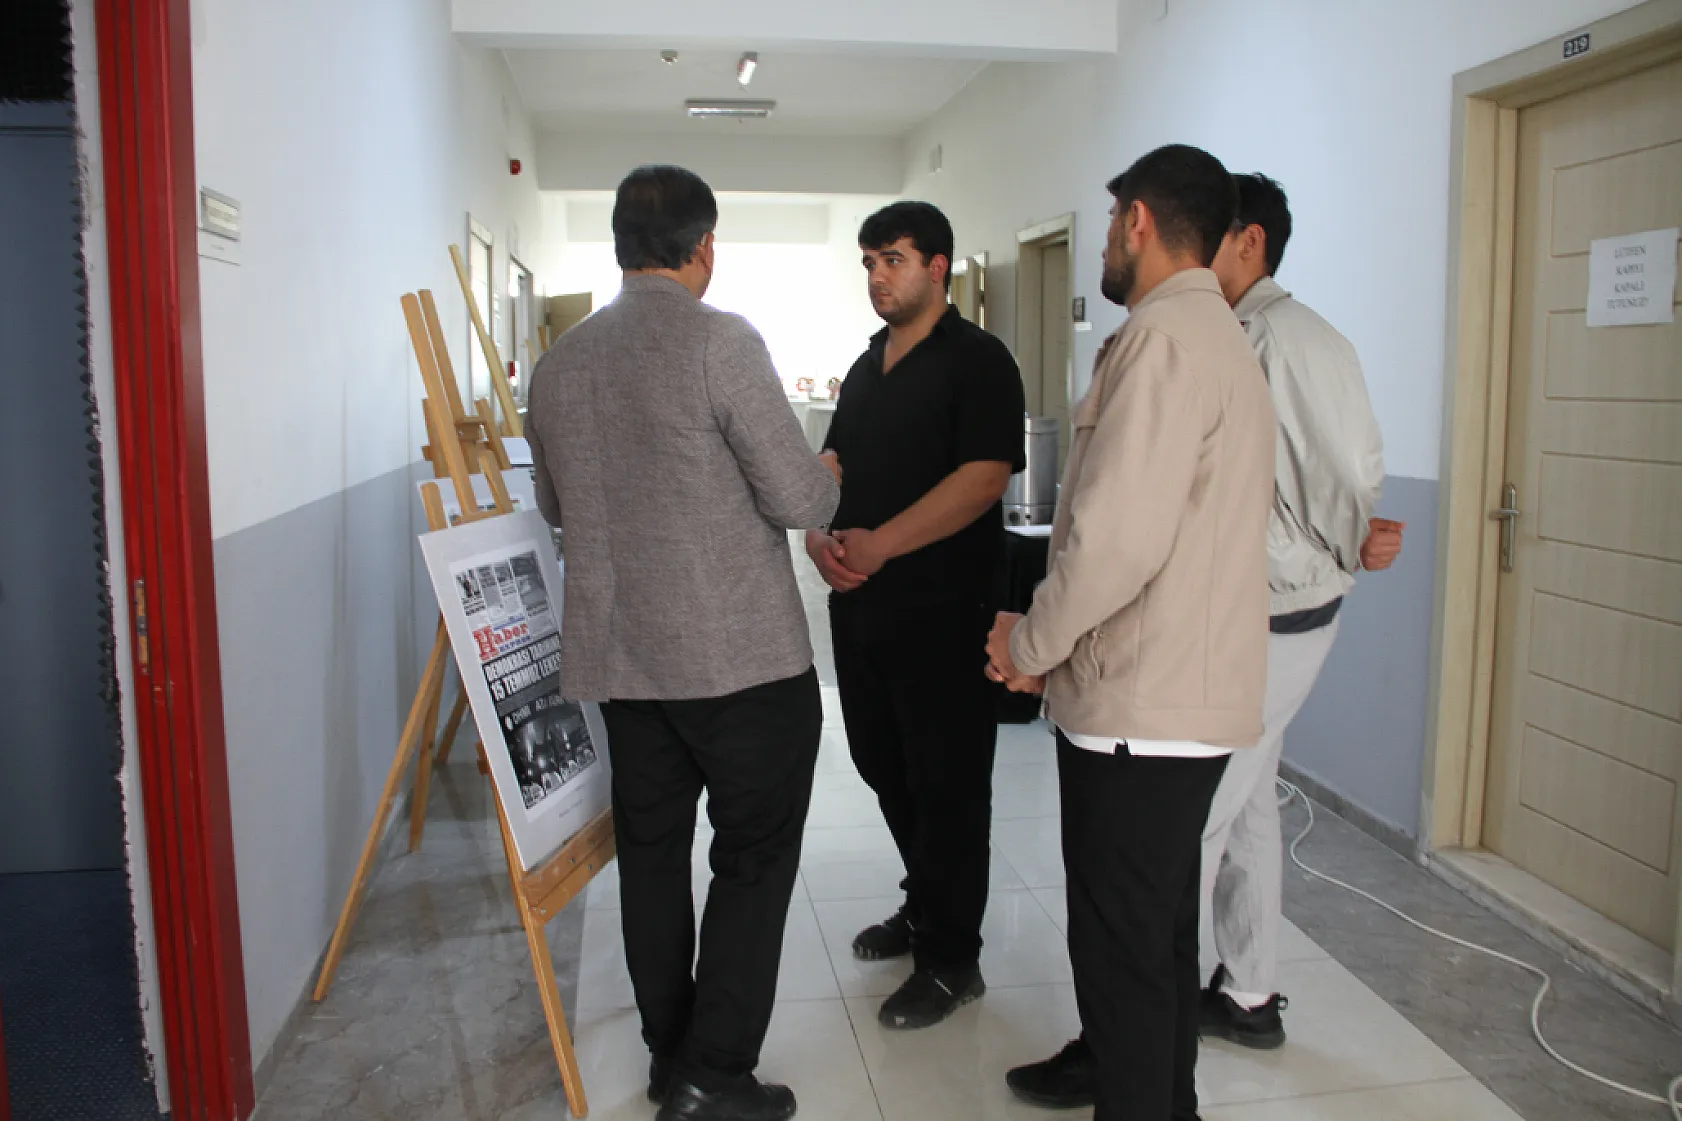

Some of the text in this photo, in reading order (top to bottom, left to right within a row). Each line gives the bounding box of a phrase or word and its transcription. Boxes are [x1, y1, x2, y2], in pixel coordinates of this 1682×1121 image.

[1565, 37, 1588, 55] 219
[472, 624, 528, 660] Haber
[491, 680, 506, 702] 15
[502, 662, 542, 697] TEMMUZ
